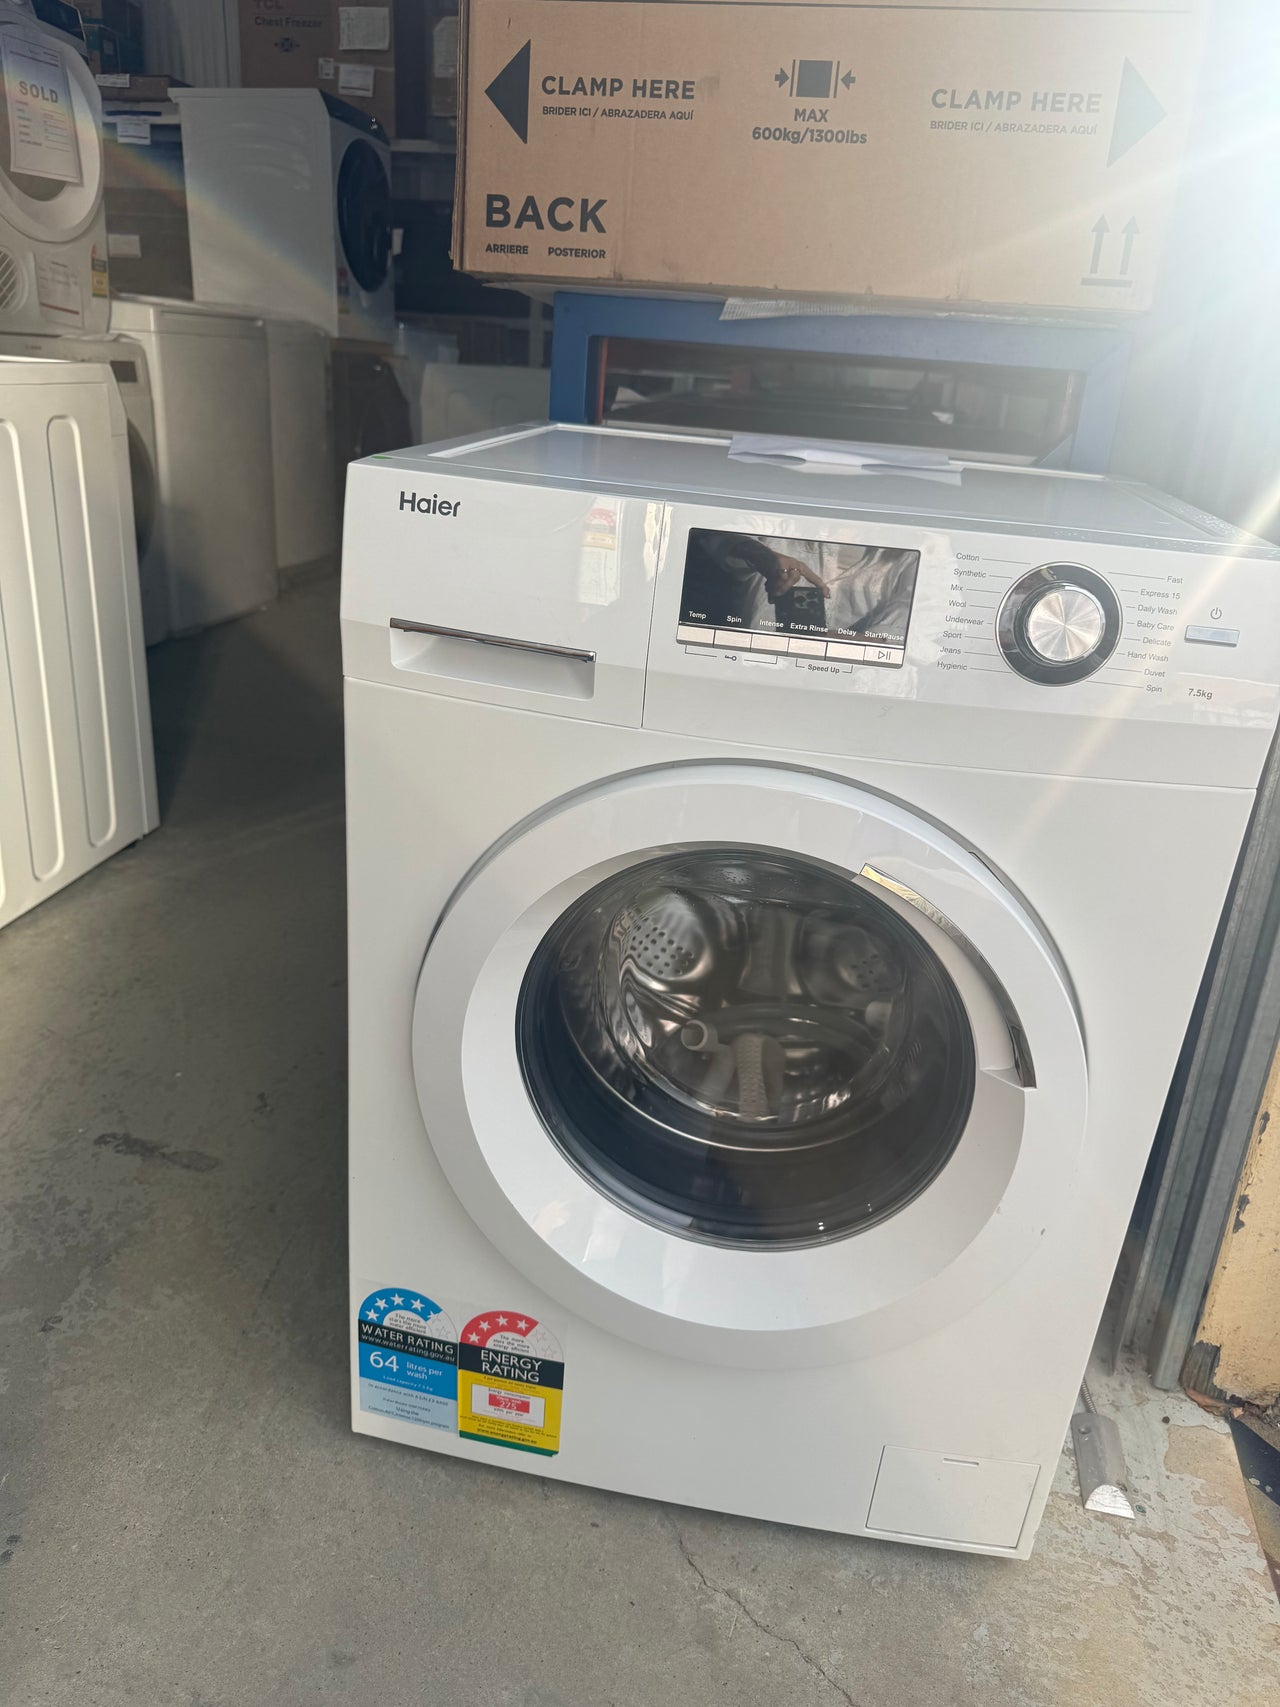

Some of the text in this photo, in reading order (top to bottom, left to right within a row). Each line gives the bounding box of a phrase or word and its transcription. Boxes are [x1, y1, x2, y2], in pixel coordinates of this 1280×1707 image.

[19, 80, 59, 103] SOLD
[541, 75, 696, 100] CLAMP HERE
[931, 88, 1102, 114] CLAMP HERE
[542, 105, 578, 118] BRIDER
[578, 107, 591, 118] ICI
[600, 108, 667, 120] ABRAZADERA
[669, 109, 694, 121] AQUÍ
[794, 108, 829, 123] MAX
[930, 120, 968, 132] BRIDER
[970, 122, 984, 132] ICI
[994, 122, 1068, 134] ABRAZADERA
[1070, 124, 1098, 136] AQUÍ
[751, 126, 868, 145] 600kg/1300lbs
[485, 193, 608, 234] BACK
[485, 243, 529, 255] ARRIERE
[548, 246, 606, 260] POSTERIOR
[399, 491, 461, 517] Haier
[956, 552, 980, 562] Cotton
[953, 568, 987, 580] Synthetic
[1166, 575, 1184, 585] Fast
[950, 584, 964, 593] Mix
[1140, 589, 1181, 600] Express 15
[949, 600, 967, 609] Wool
[1137, 604, 1178, 616] Daily Wash
[688, 610, 707, 621] Temp
[726, 615, 742, 624] Spin
[945, 615, 984, 627] Underwear
[759, 619, 784, 628] Intense
[790, 622, 829, 634] Extra Rinse
[1136, 620, 1175, 632] Baby Care
[838, 627, 857, 638] Delay
[864, 630, 905, 642] Start/Pause
[942, 631, 962, 641] Sport
[1142, 636, 1172, 647] Delicate
[1127, 650, 1169, 663] Hand Wash
[808, 664, 840, 675] Speed Up
[937, 662, 968, 673] Hygienic
[1144, 668, 1166, 678] Duvet
[1146, 684, 1162, 694] Spin
[1187, 688, 1213, 701] 7.5kg
[361, 1323, 454, 1354] WATER RATING
[361, 1334, 456, 1362] www.waterrating.gov.au
[370, 1351, 400, 1373] 64
[481, 1350, 542, 1371] ENERGY
[406, 1361, 444, 1377] litres per
[406, 1370, 428, 1380] wash
[482, 1362, 540, 1383] RATING
